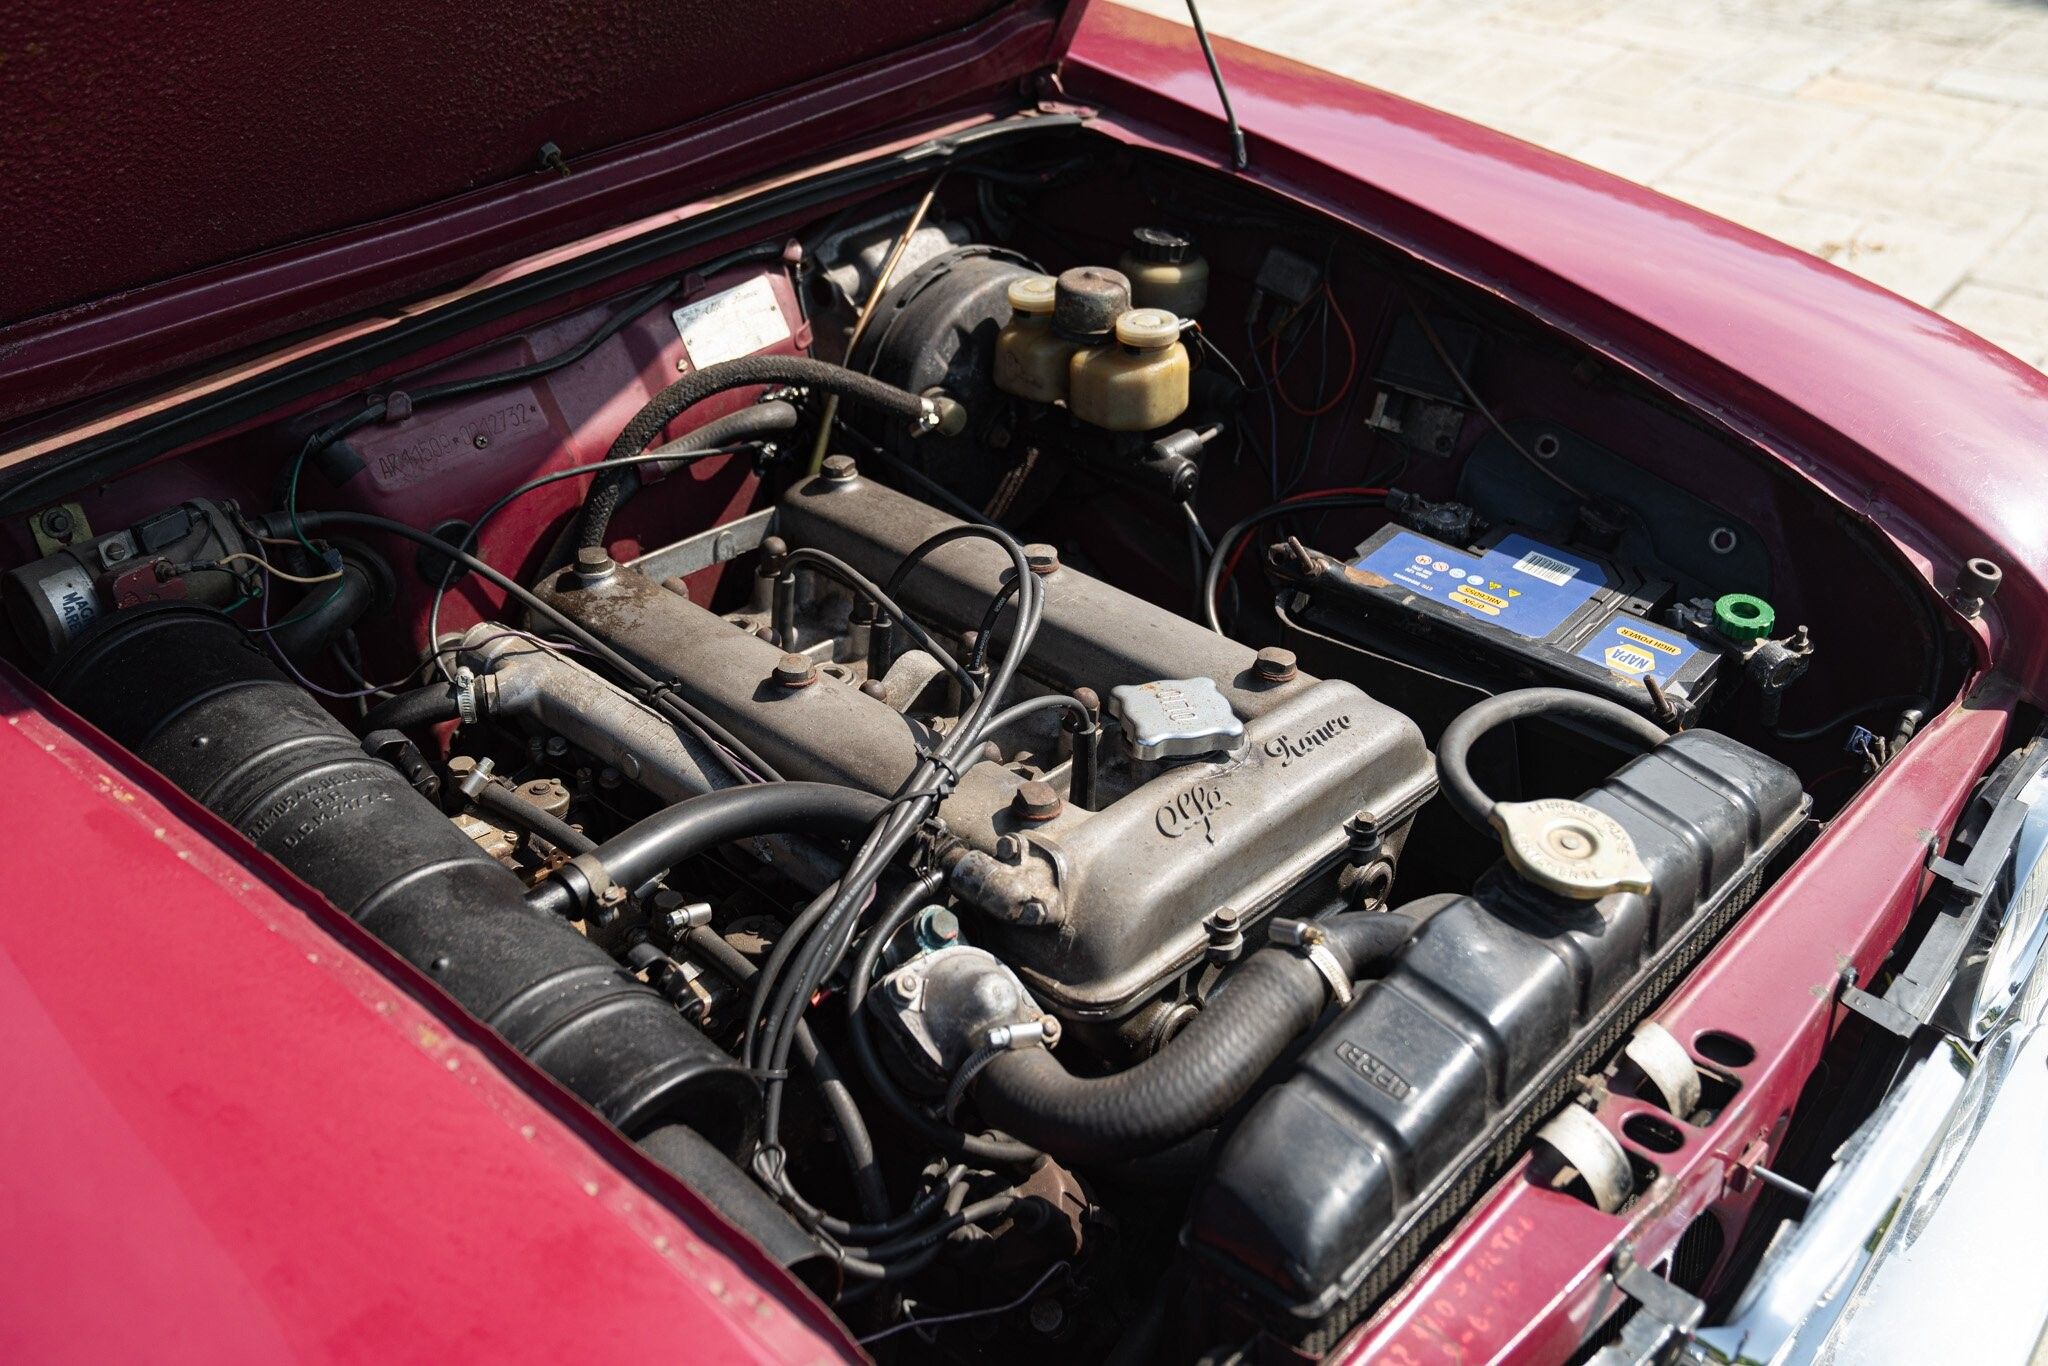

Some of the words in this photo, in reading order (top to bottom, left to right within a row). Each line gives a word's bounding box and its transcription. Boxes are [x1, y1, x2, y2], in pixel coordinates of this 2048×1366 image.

[1621, 629, 1654, 645] POWER
[1654, 641, 1676, 653] HIGH
[1612, 648, 1649, 670] NAPA
[1155, 784, 1232, 846] Alfa
[1264, 715, 1351, 768] Romeo
